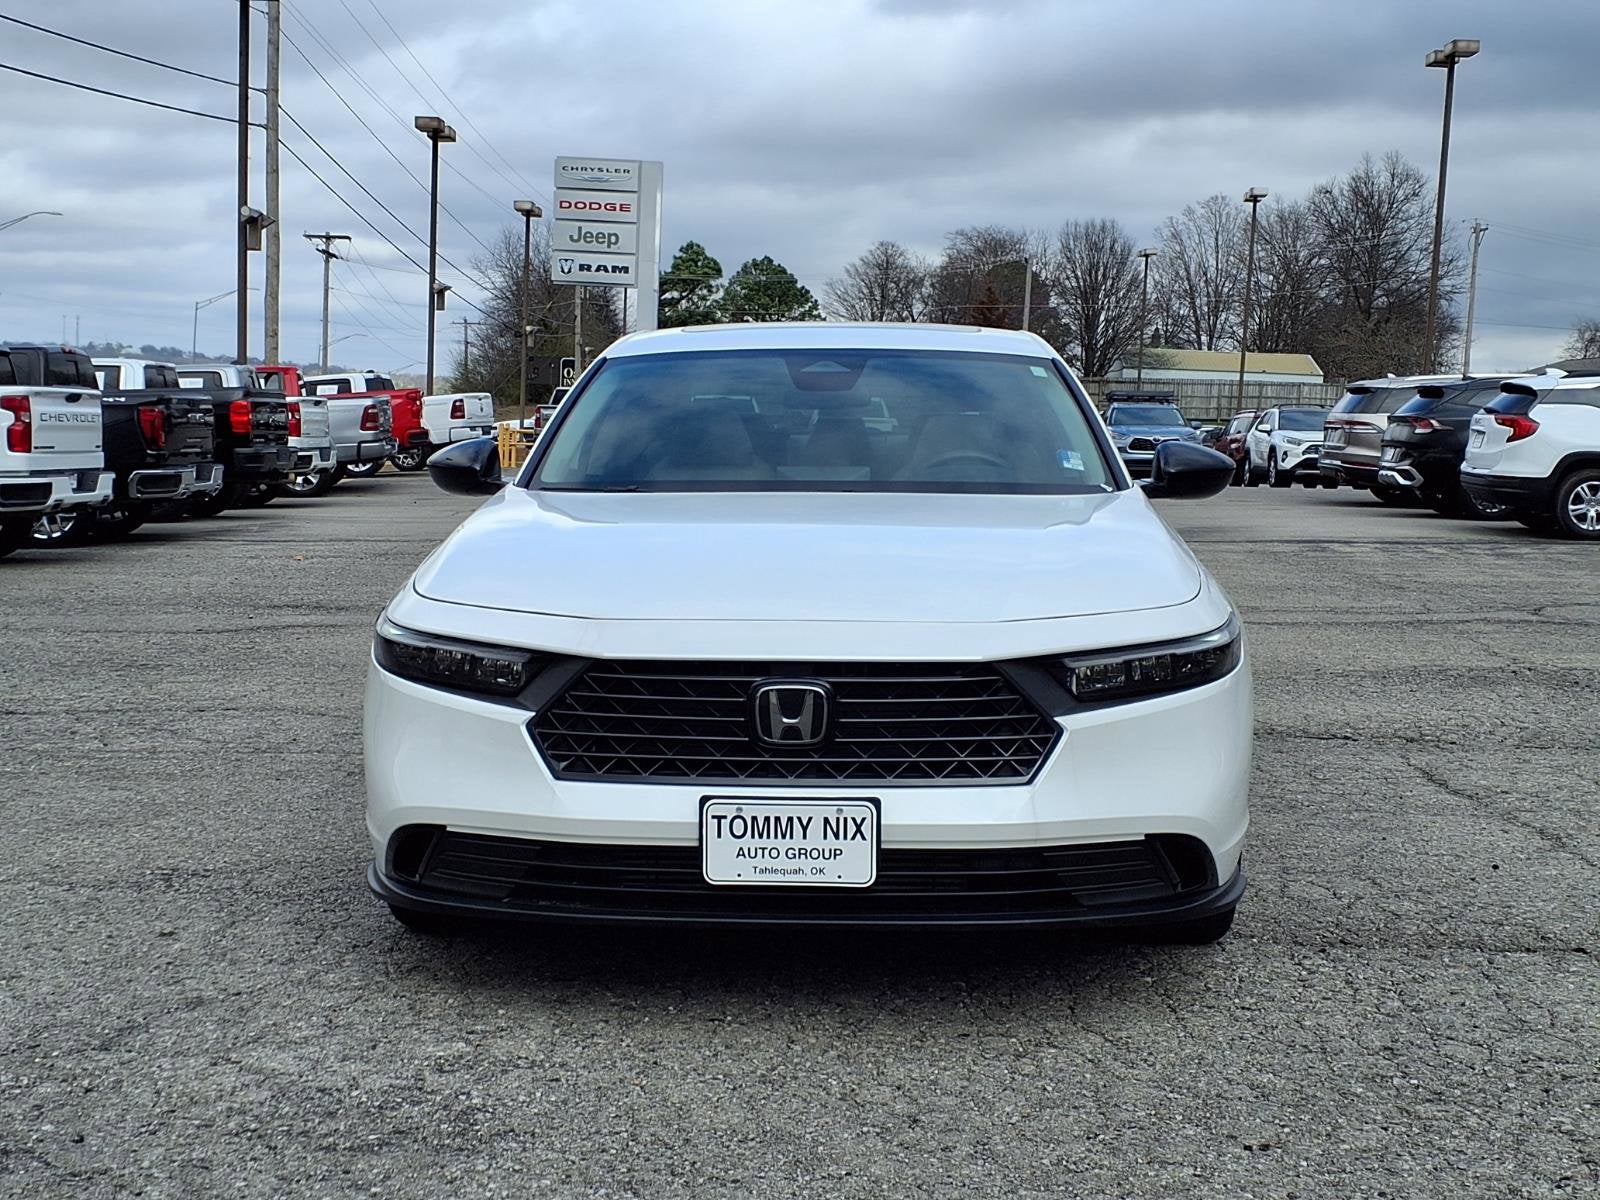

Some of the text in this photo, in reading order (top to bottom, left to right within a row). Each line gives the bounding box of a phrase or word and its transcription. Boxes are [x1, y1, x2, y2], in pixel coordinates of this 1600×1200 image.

[561, 165, 631, 174] CHRYSLER
[559, 200, 632, 212] DODGE
[568, 226, 620, 249] Jeep
[578, 264, 630, 274] RAM
[40, 412, 101, 423] CHEVROLET
[711, 815, 867, 841] TOMMY NIX
[736, 847, 843, 860] AUTO GROUP
[752, 866, 826, 877] Tahlequah, OK
